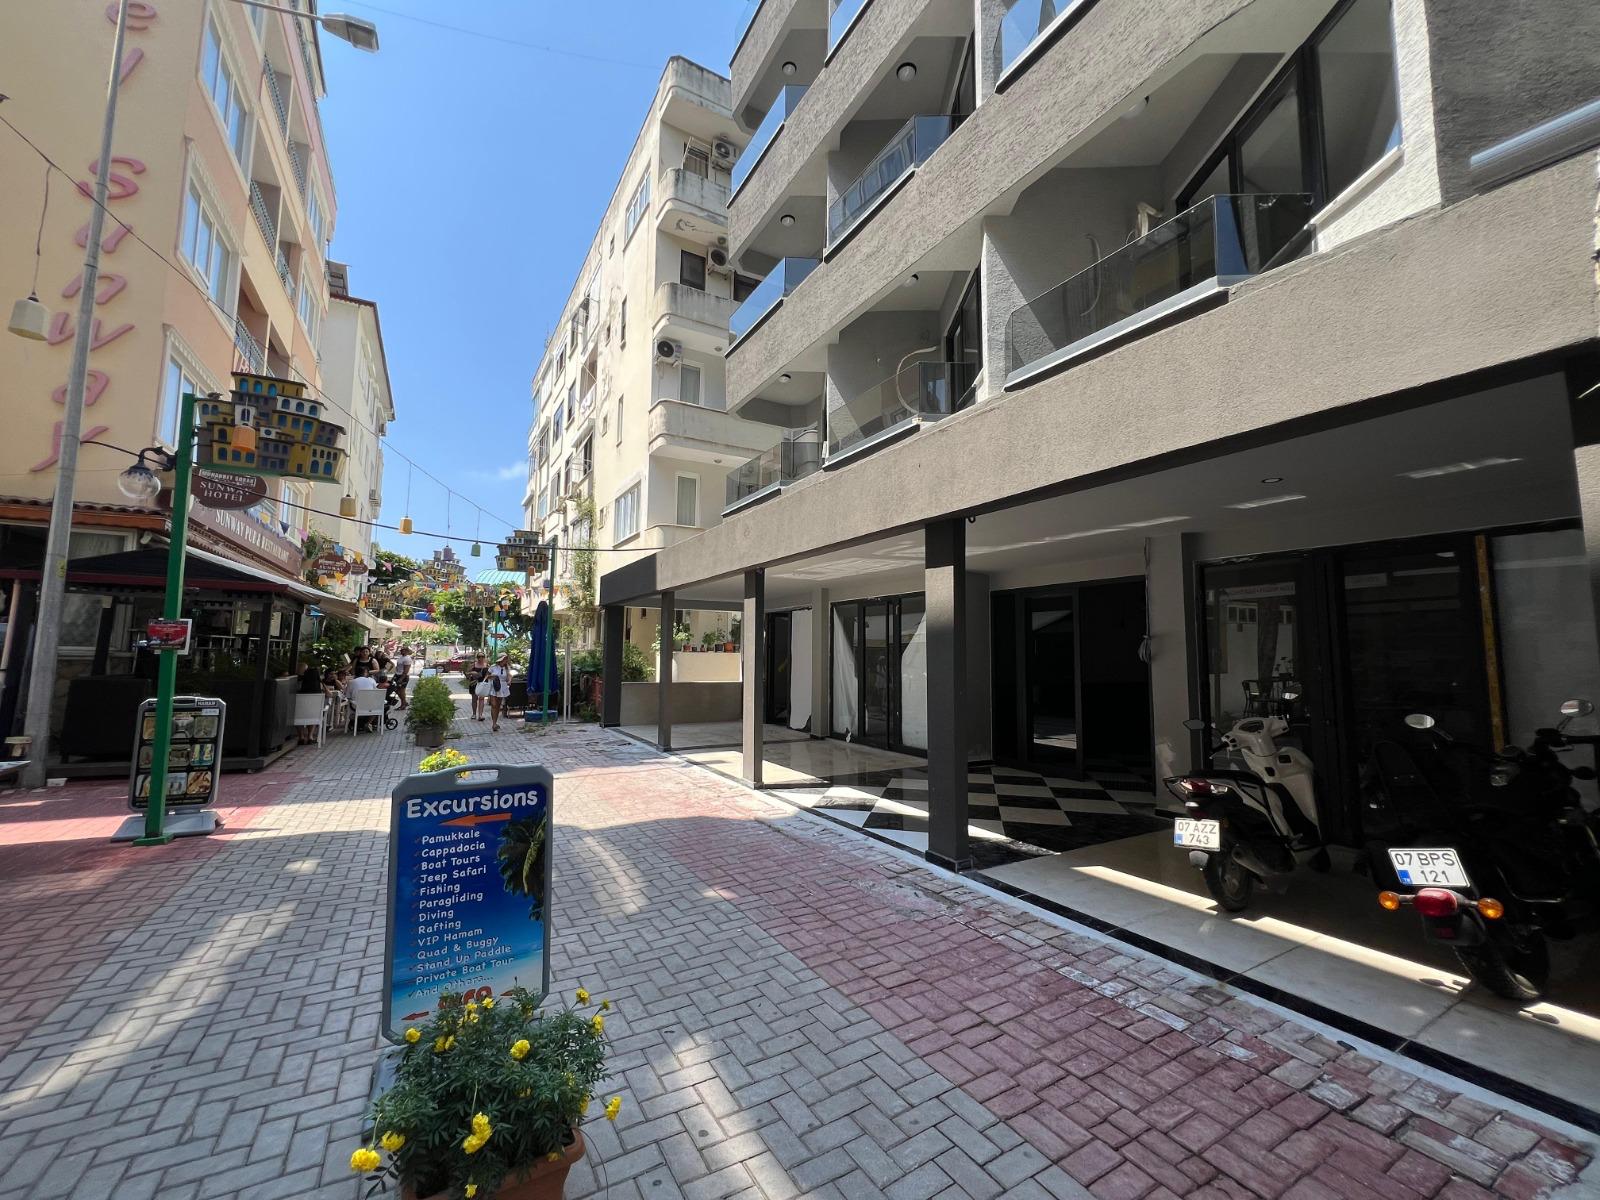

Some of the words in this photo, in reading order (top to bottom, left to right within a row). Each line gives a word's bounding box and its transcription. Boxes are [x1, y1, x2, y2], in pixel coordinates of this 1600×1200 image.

[204, 489, 243, 502] HOTEL
[215, 509, 245, 537] SUNWAY
[244, 526, 256, 544] PUB
[406, 790, 538, 818] Excursions
[1178, 821, 1190, 832] 07
[1193, 823, 1217, 834] AZZ
[421, 829, 480, 845] Pamukkale
[1189, 833, 1210, 845] 743
[421, 841, 486, 858] Cappadocia
[420, 859, 447, 871] Boat
[451, 854, 480, 866] Tours
[1394, 853, 1413, 866] 07
[1416, 853, 1455, 866] BPS
[420, 871, 447, 884] Jeep
[452, 865, 487, 878] Safari
[1420, 870, 1450, 883] 121
[420, 882, 460, 896] Fishing
[419, 891, 484, 909] Paragliding
[419, 909, 454, 922] Diving
[418, 919, 461, 934] Rafting
[418, 934, 440, 947] VIP
[444, 927, 483, 943] Hamam
[417, 945, 448, 960] Quad
[453, 943, 461, 952] &
[466, 935, 499, 951] Buggy
[416, 957, 450, 973] Stand
[456, 953, 470, 967] Up
[474, 945, 512, 961] Paddle
[415, 969, 457, 985] Private
[462, 961, 486, 975] Boat
[490, 955, 515, 968] Tour
[415, 984, 439, 1000] And
